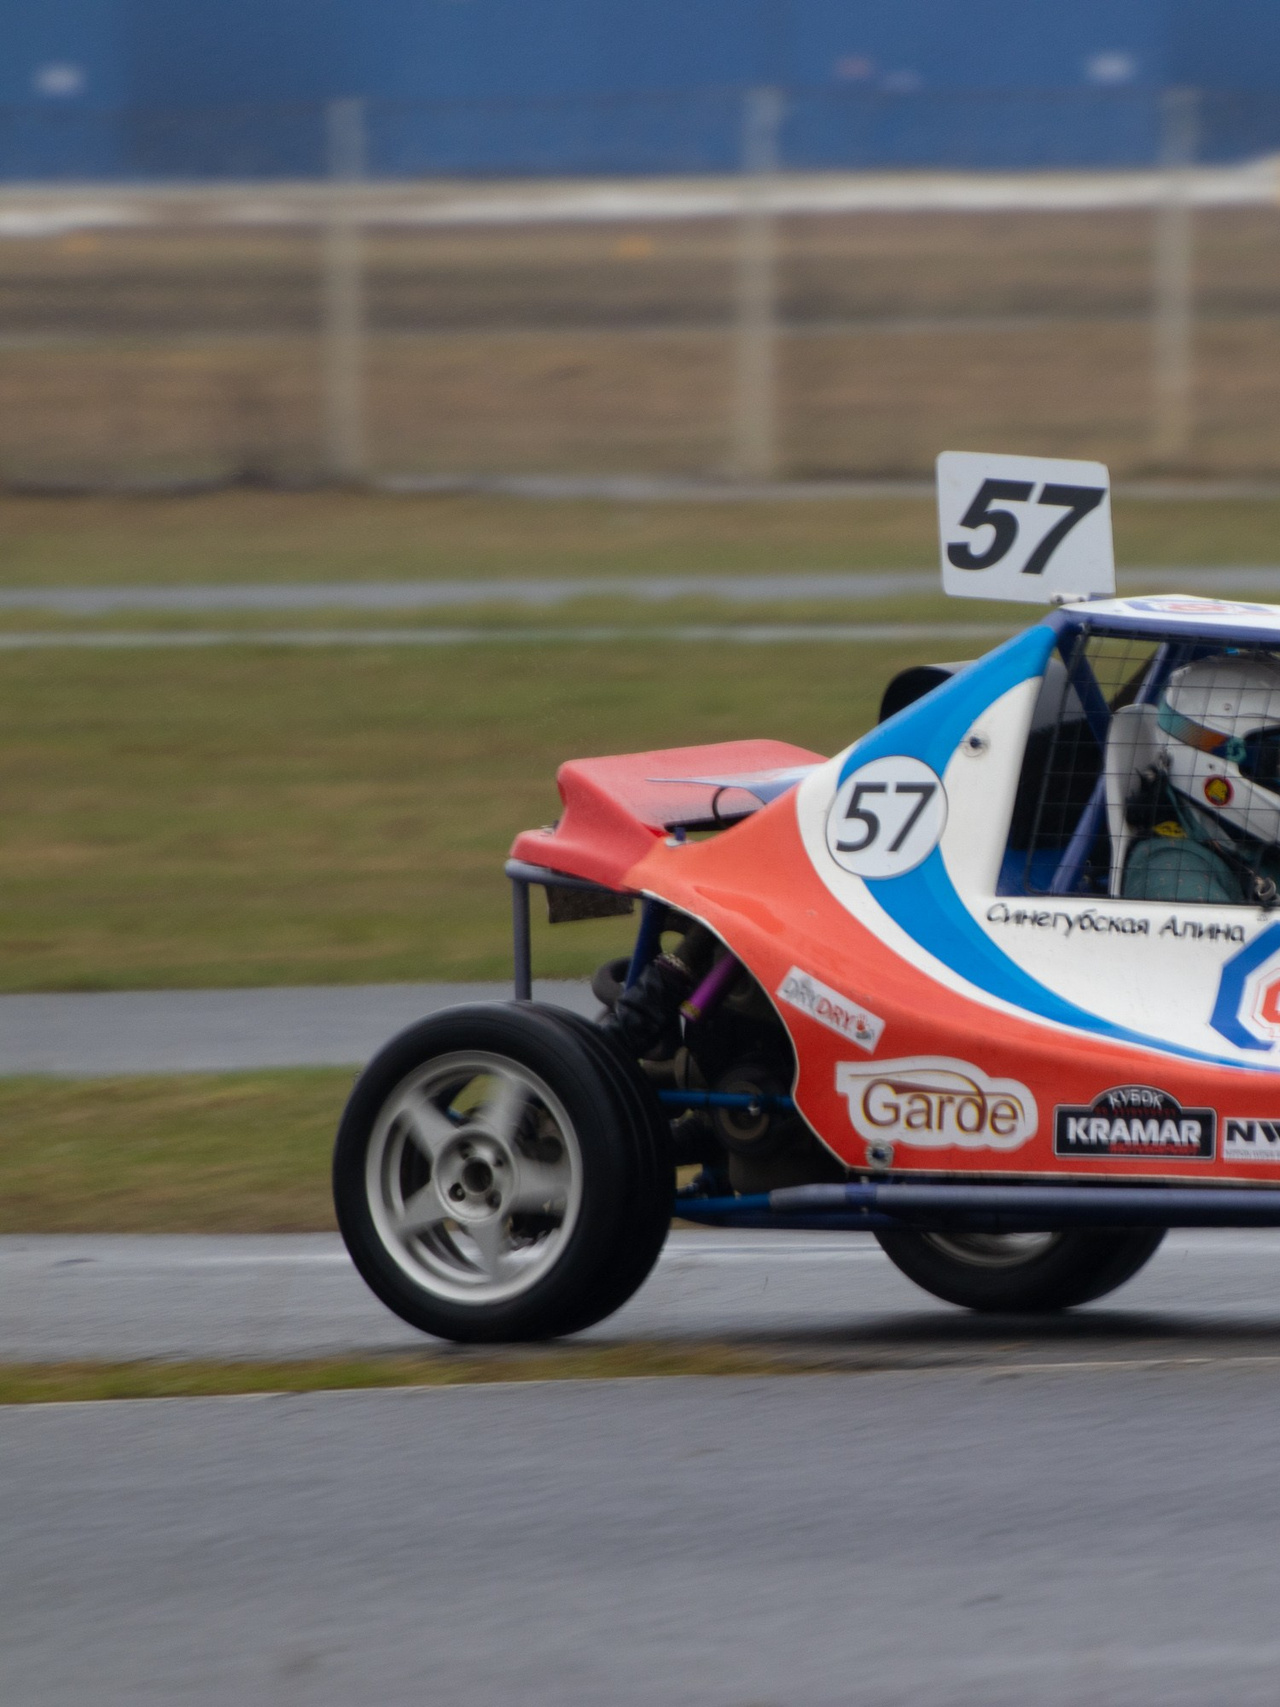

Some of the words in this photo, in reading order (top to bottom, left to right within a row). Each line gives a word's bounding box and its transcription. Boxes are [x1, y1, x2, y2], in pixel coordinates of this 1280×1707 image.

[947, 478, 1107, 575] 57
[836, 781, 937, 852] 57
[986, 902, 1149, 938] Синегубская
[1159, 914, 1245, 945] Алина
[860, 1076, 1020, 1136] Garde
[1066, 1117, 1202, 1147] KRAMAR
